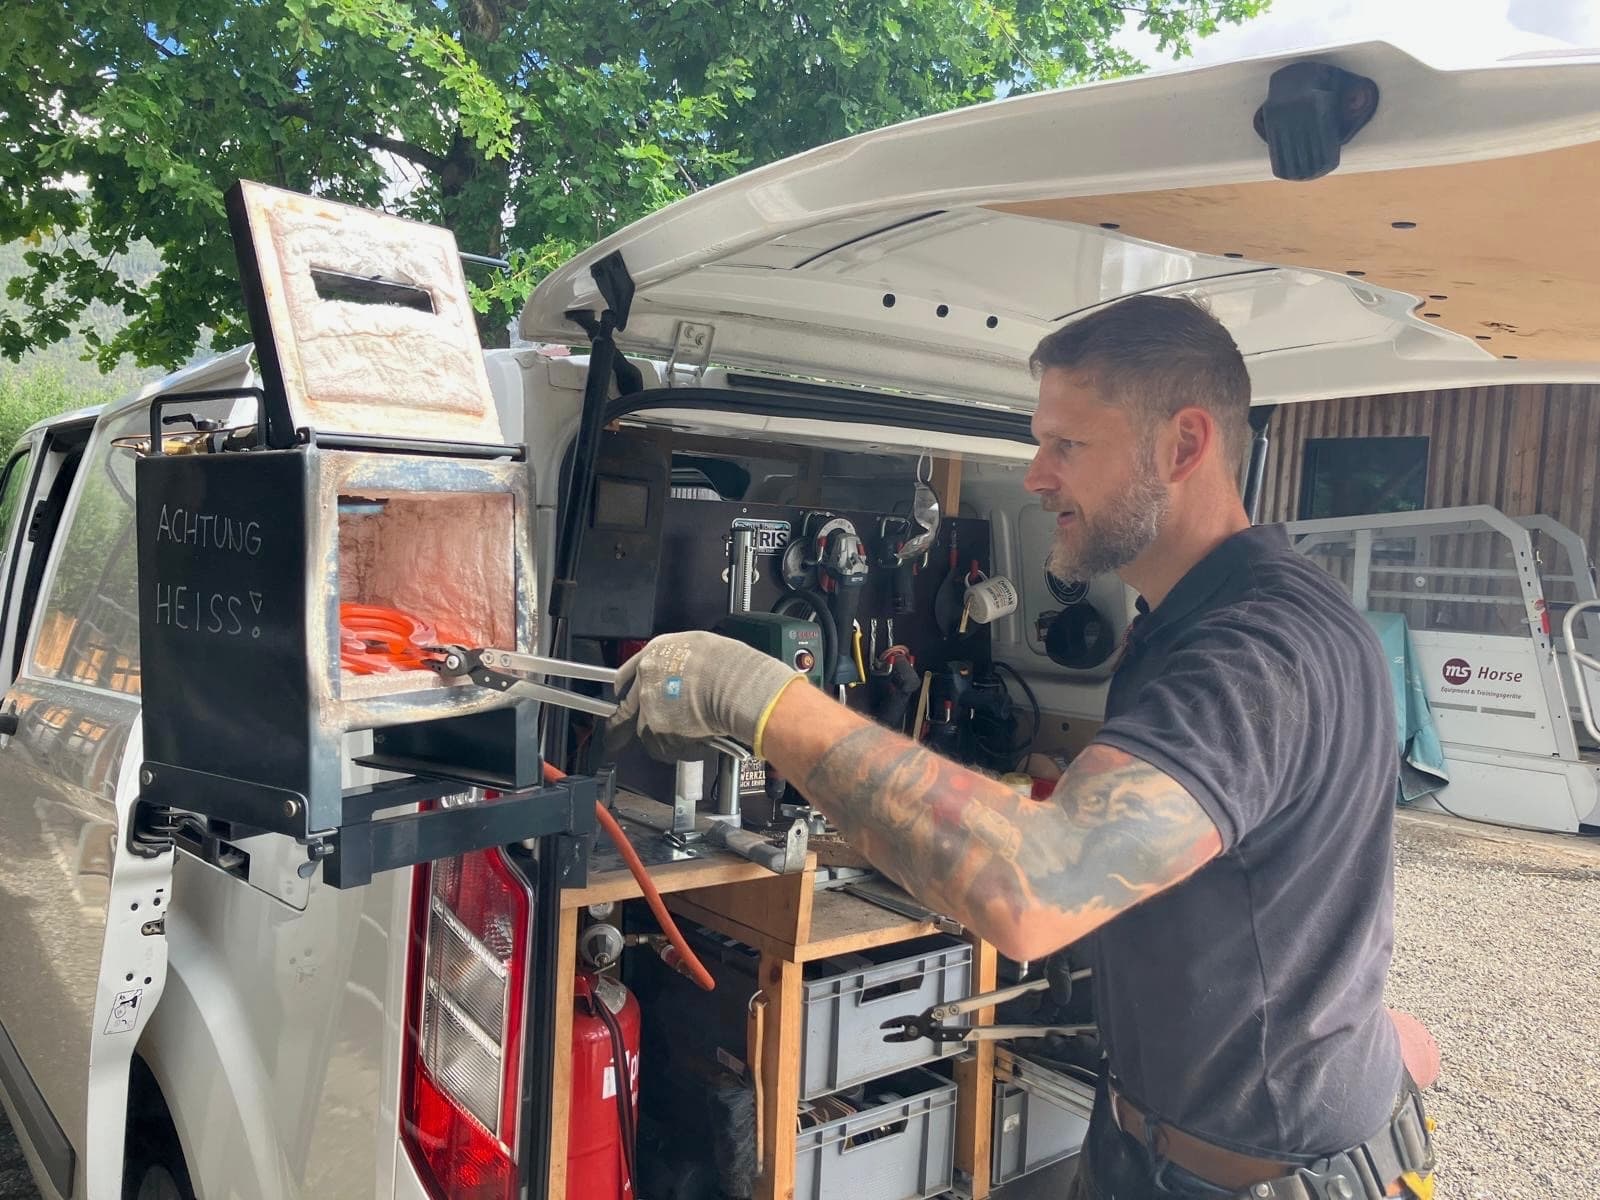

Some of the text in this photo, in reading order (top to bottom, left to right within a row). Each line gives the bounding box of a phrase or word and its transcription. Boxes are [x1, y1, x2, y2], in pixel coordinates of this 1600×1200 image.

[157, 504, 261, 555] ACHTUNG
[759, 531, 788, 548] RIS
[156, 583, 262, 638] HEISS!
[1477, 666, 1523, 683] Horse
[1441, 686, 1471, 695] Equipment
[1476, 689, 1522, 700] Trainingsgeräte
[740, 770, 766, 781] WERKZ
